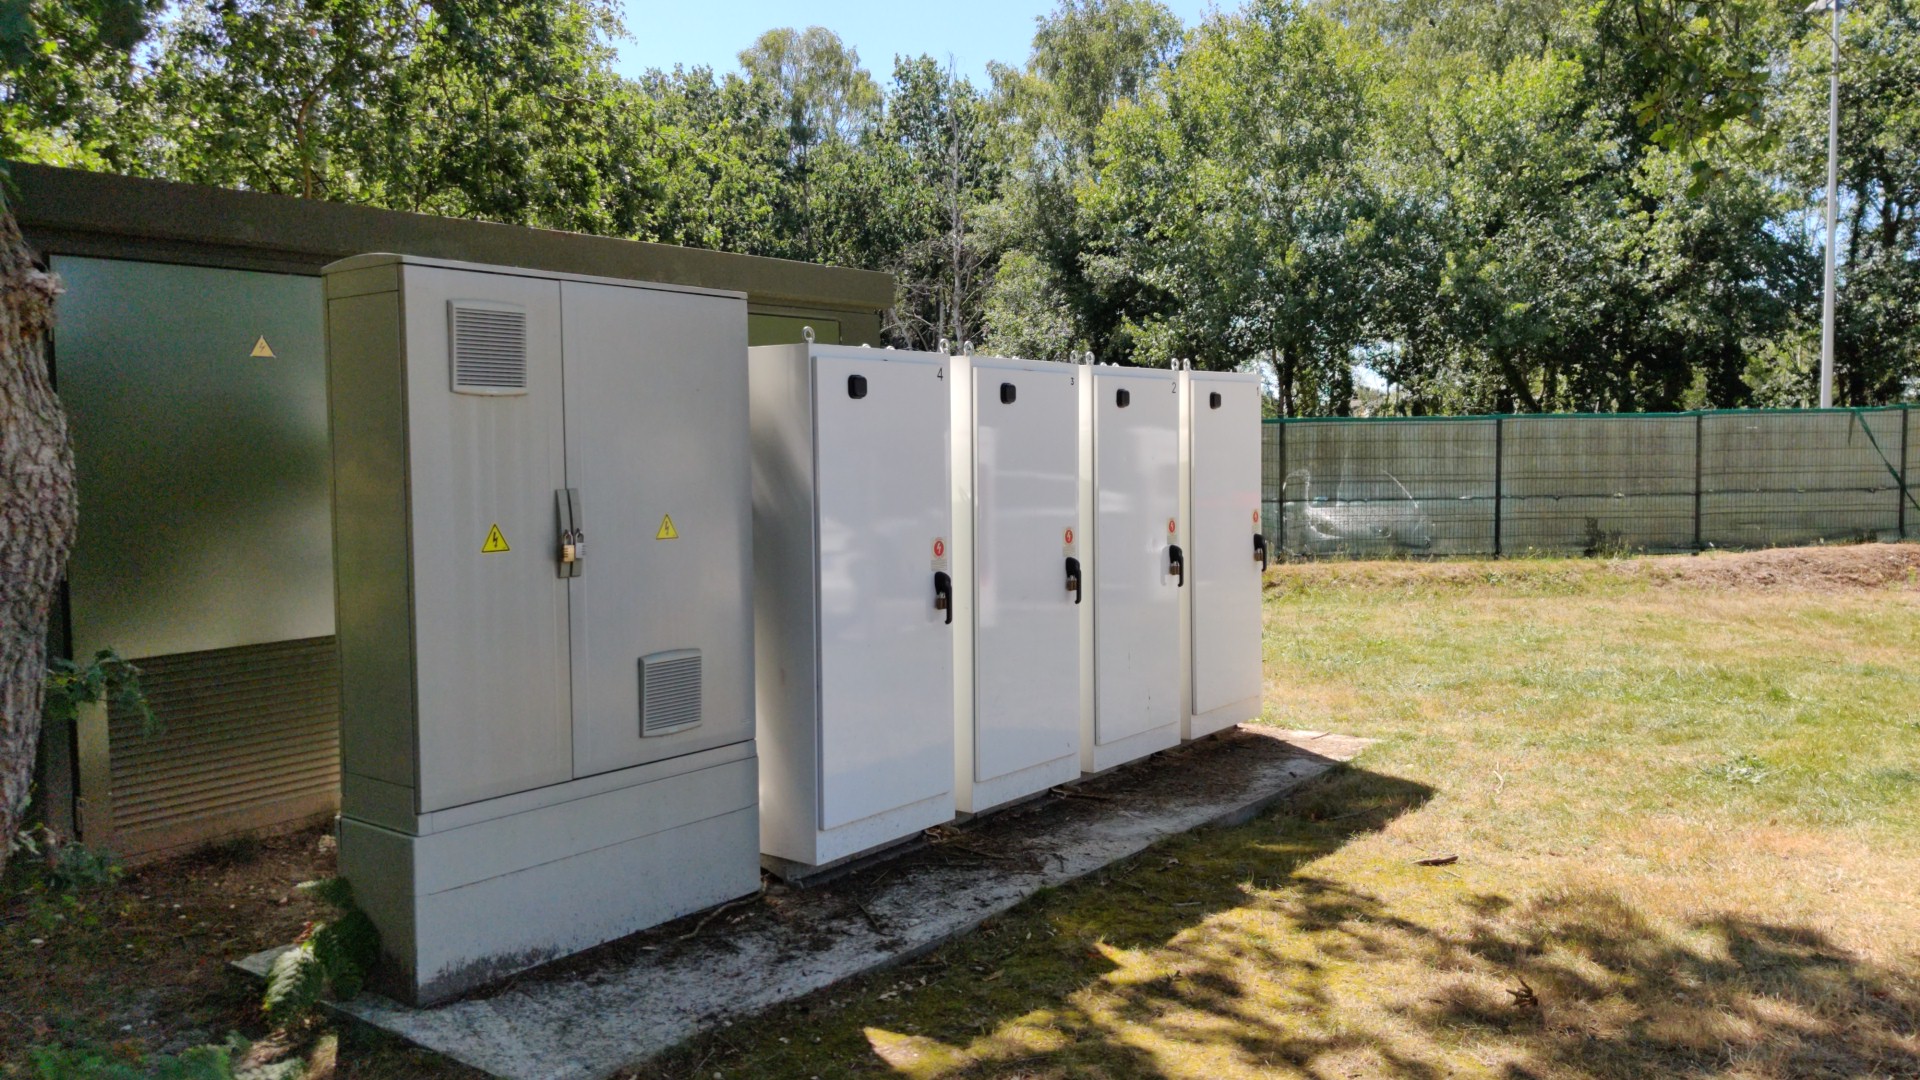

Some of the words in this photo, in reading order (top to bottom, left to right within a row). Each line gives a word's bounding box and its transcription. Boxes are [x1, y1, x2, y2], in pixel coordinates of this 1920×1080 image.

[936, 367, 944, 381] 4
[1070, 376, 1075, 386] 3
[1171, 381, 1177, 394] 2
